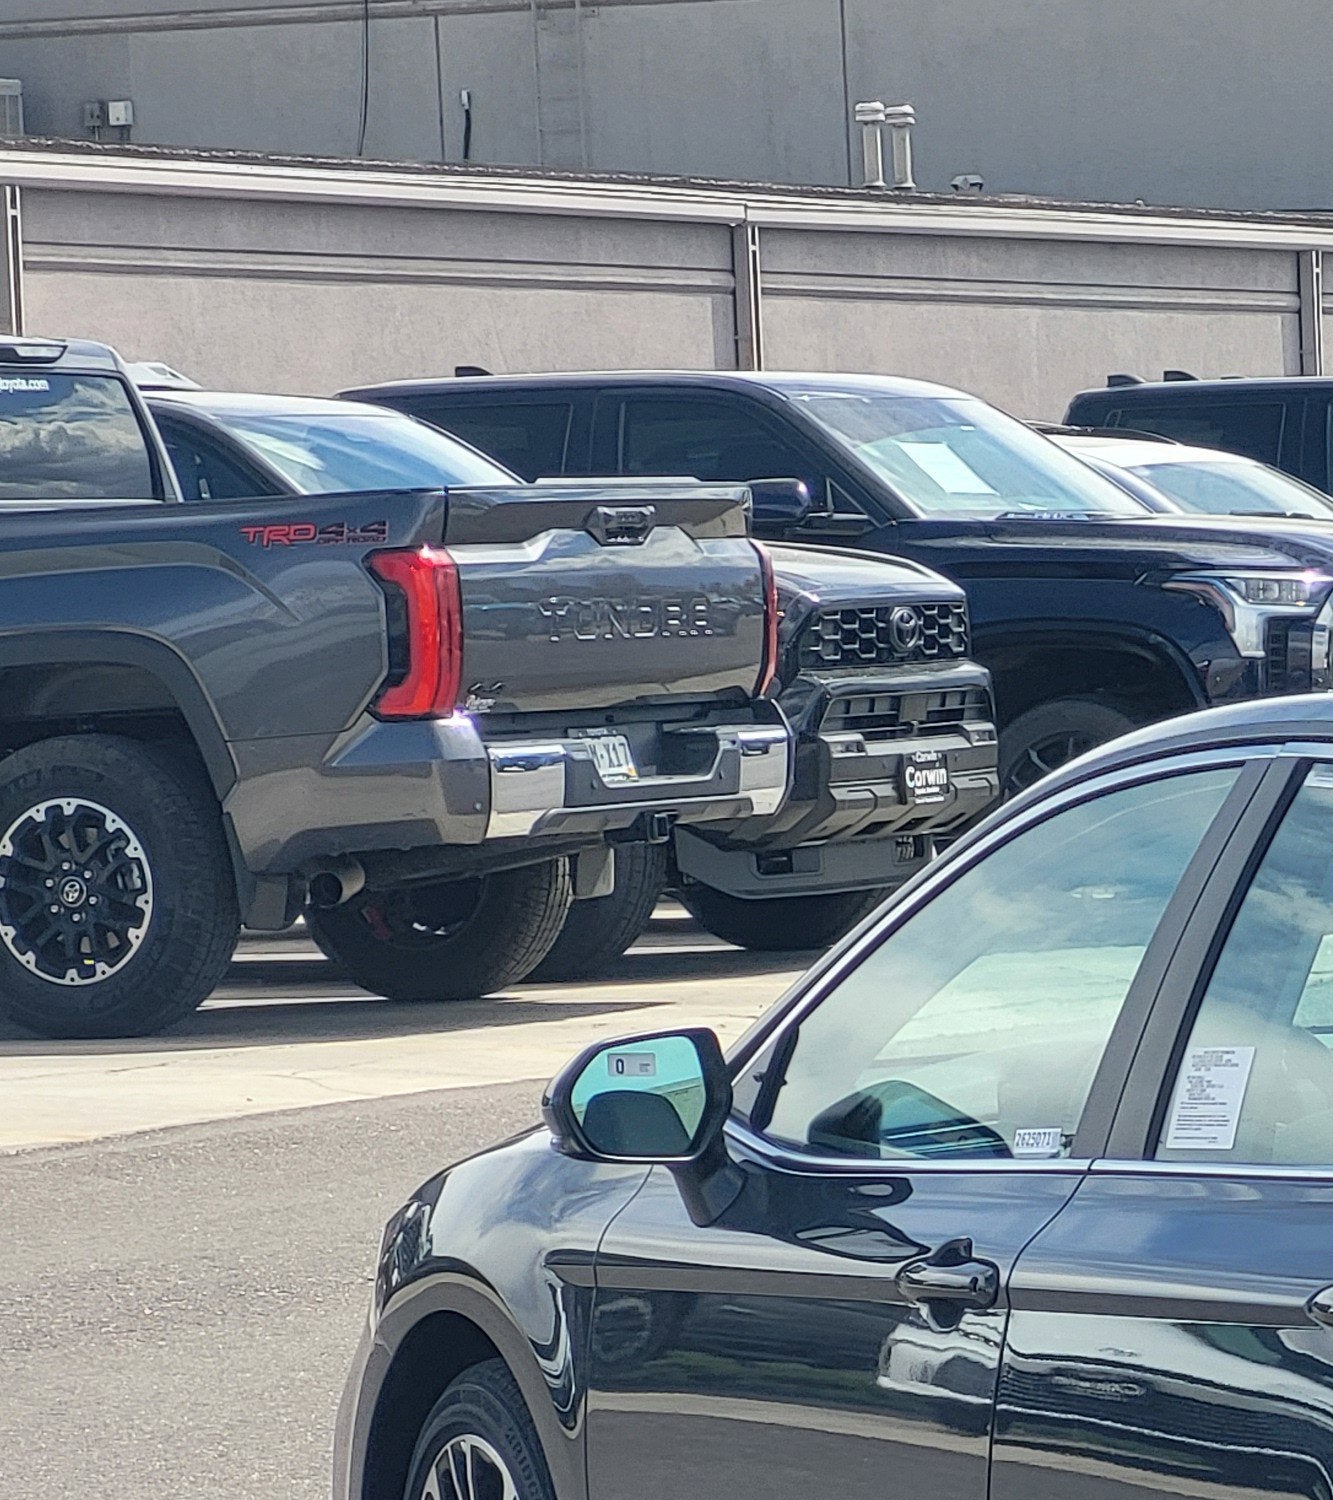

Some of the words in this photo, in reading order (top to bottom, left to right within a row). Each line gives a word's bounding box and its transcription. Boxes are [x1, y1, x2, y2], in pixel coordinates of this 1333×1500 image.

[0, 377, 50, 394] oyota.com
[240, 523, 316, 547] TRD
[538, 595, 714, 643] TUNDRA
[905, 765, 947, 788] Corwin
